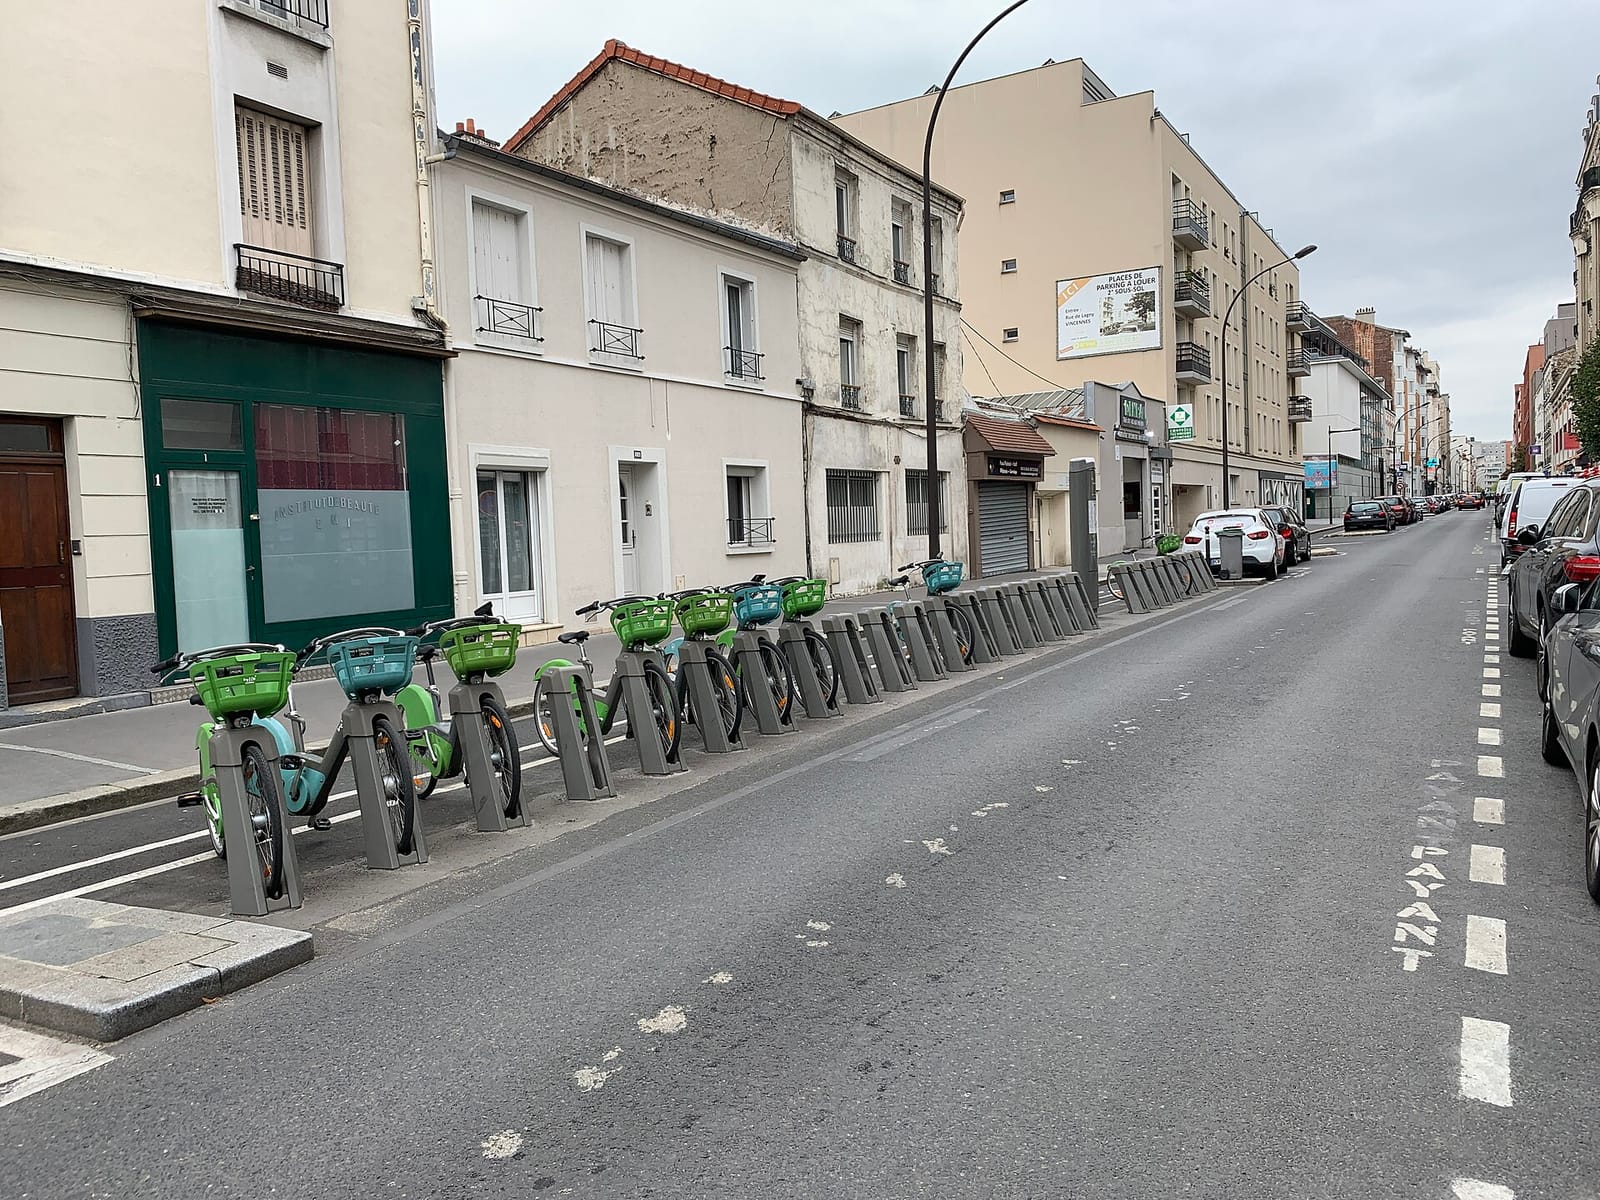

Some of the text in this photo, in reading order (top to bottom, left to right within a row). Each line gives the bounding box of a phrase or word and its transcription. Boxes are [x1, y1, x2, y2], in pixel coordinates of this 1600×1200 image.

[1096, 281, 1126, 291] PARKING
[1133, 277, 1156, 286] LOUER
[1108, 273, 1132, 283] PLACES
[1062, 283, 1079, 300] ICI
[1115, 285, 1145, 295] SOUS-SOL
[203, 453, 208, 462] 1
[154, 473, 161, 487] 1
[274, 498, 326, 521] INSTITUT
[1391, 845, 1449, 972] PAYANT
